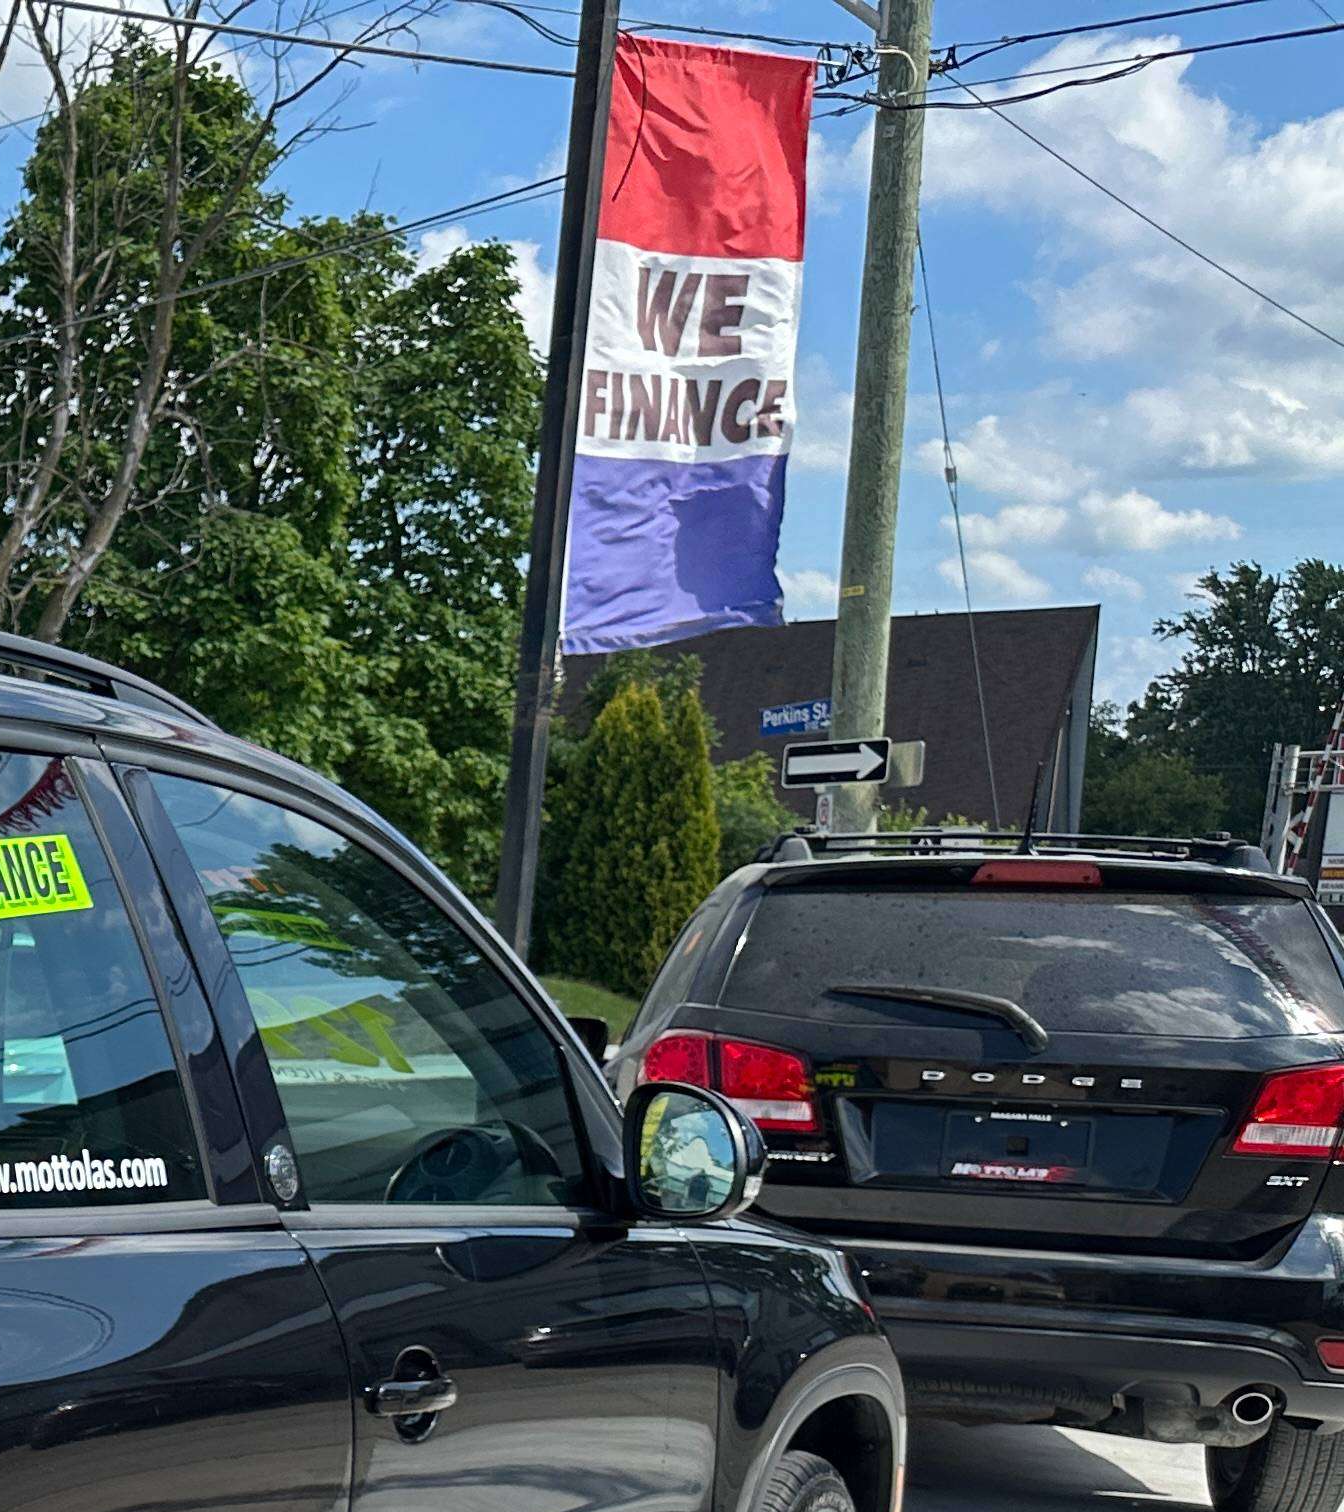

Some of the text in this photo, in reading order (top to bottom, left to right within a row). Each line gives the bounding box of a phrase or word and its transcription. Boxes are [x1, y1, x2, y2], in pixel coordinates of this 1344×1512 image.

[636, 266, 750, 358] WE
[582, 369, 788, 446] FINANCE
[762, 705, 811, 730] Perkins
[921, 1070, 1143, 1089] DODGE
